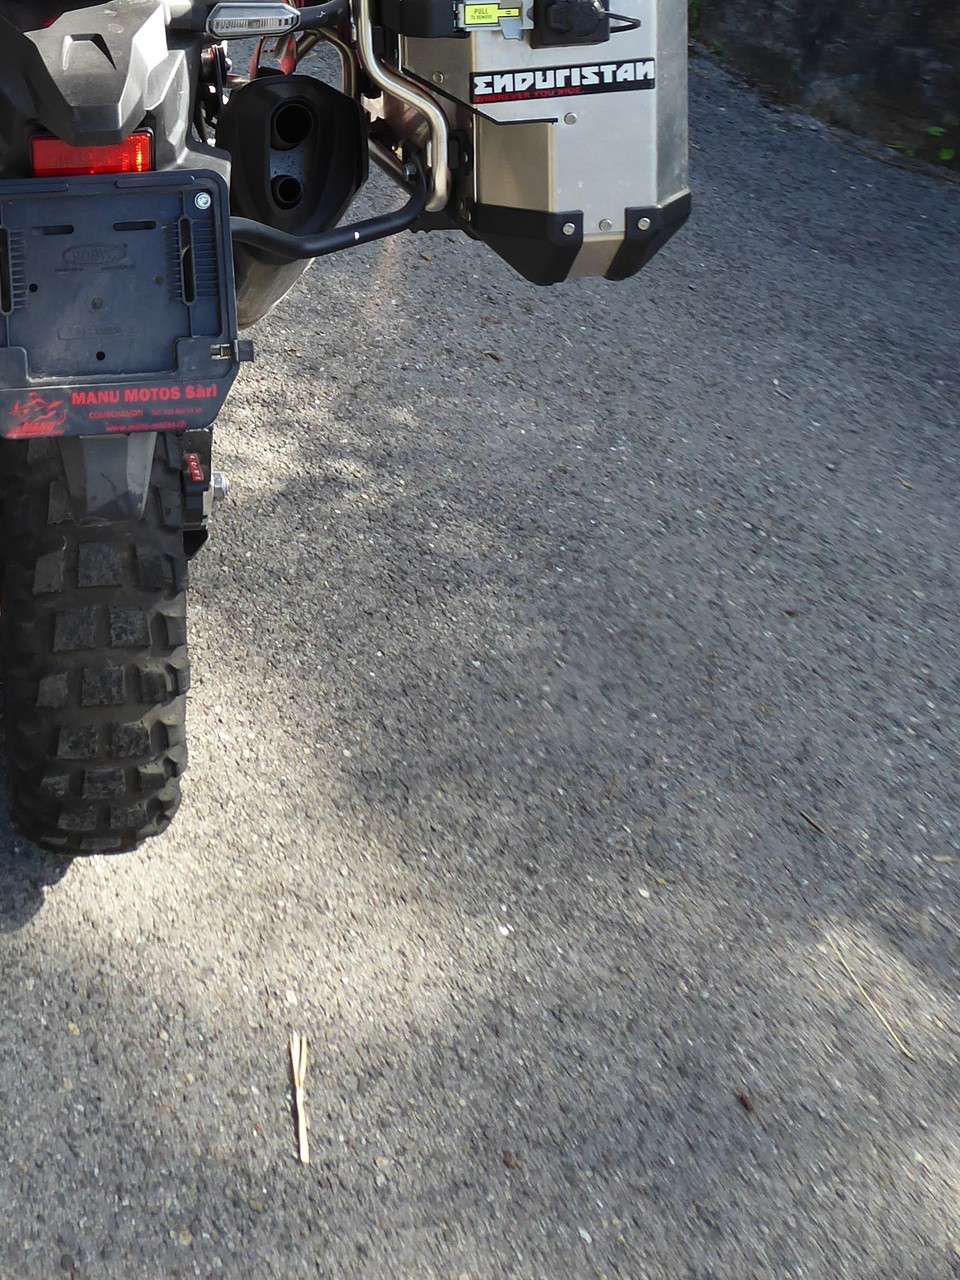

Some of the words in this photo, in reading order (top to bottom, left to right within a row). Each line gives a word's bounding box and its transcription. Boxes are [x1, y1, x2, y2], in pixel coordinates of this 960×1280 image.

[473, 60, 655, 95] ENDURISTAN
[534, 88, 554, 98] YOU
[70, 388, 120, 406] MANU
[124, 386, 181, 403] MOTOS
